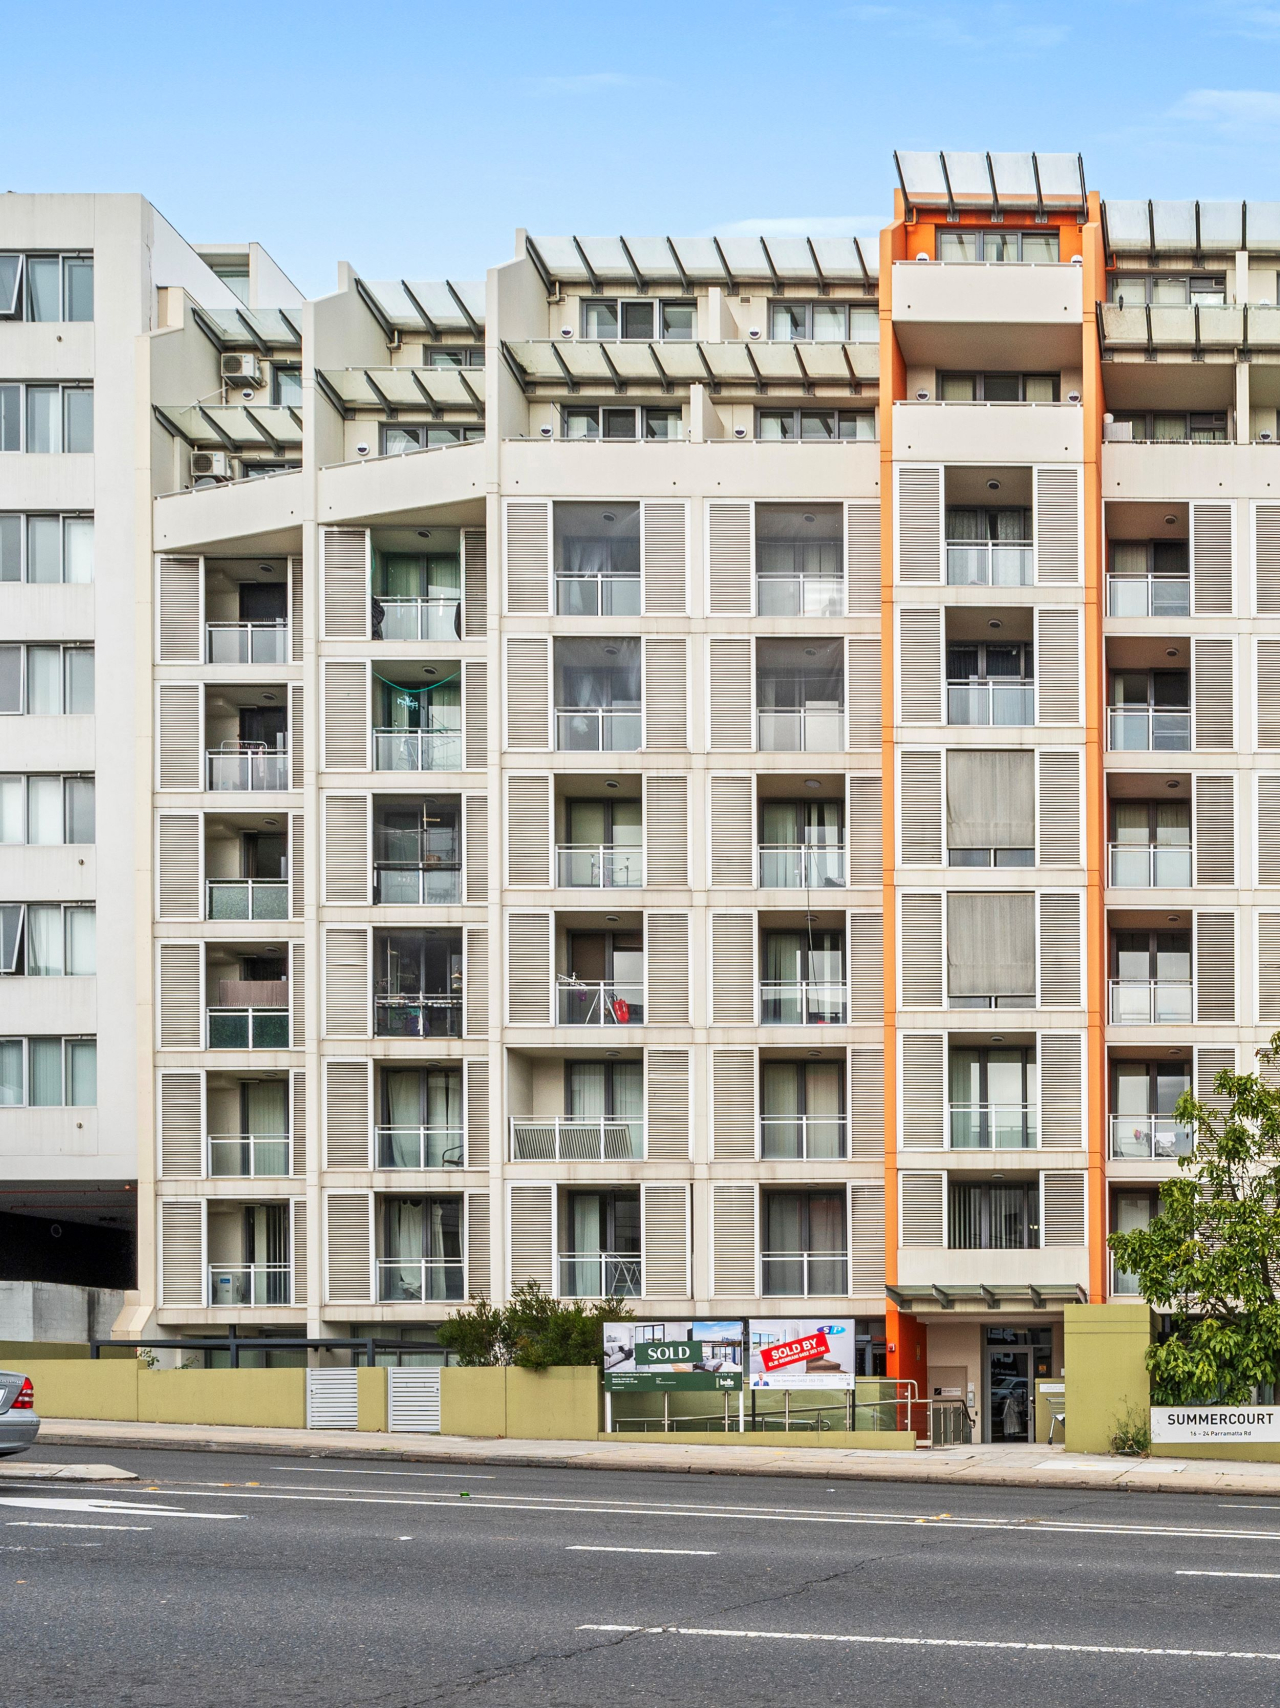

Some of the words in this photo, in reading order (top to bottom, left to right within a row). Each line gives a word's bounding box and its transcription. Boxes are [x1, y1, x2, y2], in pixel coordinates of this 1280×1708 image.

[647, 1346, 690, 1360] SOLD
[771, 1344, 800, 1360] SOLD
[802, 1338, 817, 1350] BY
[1167, 1413, 1274, 1425] SUMMERCOURT
